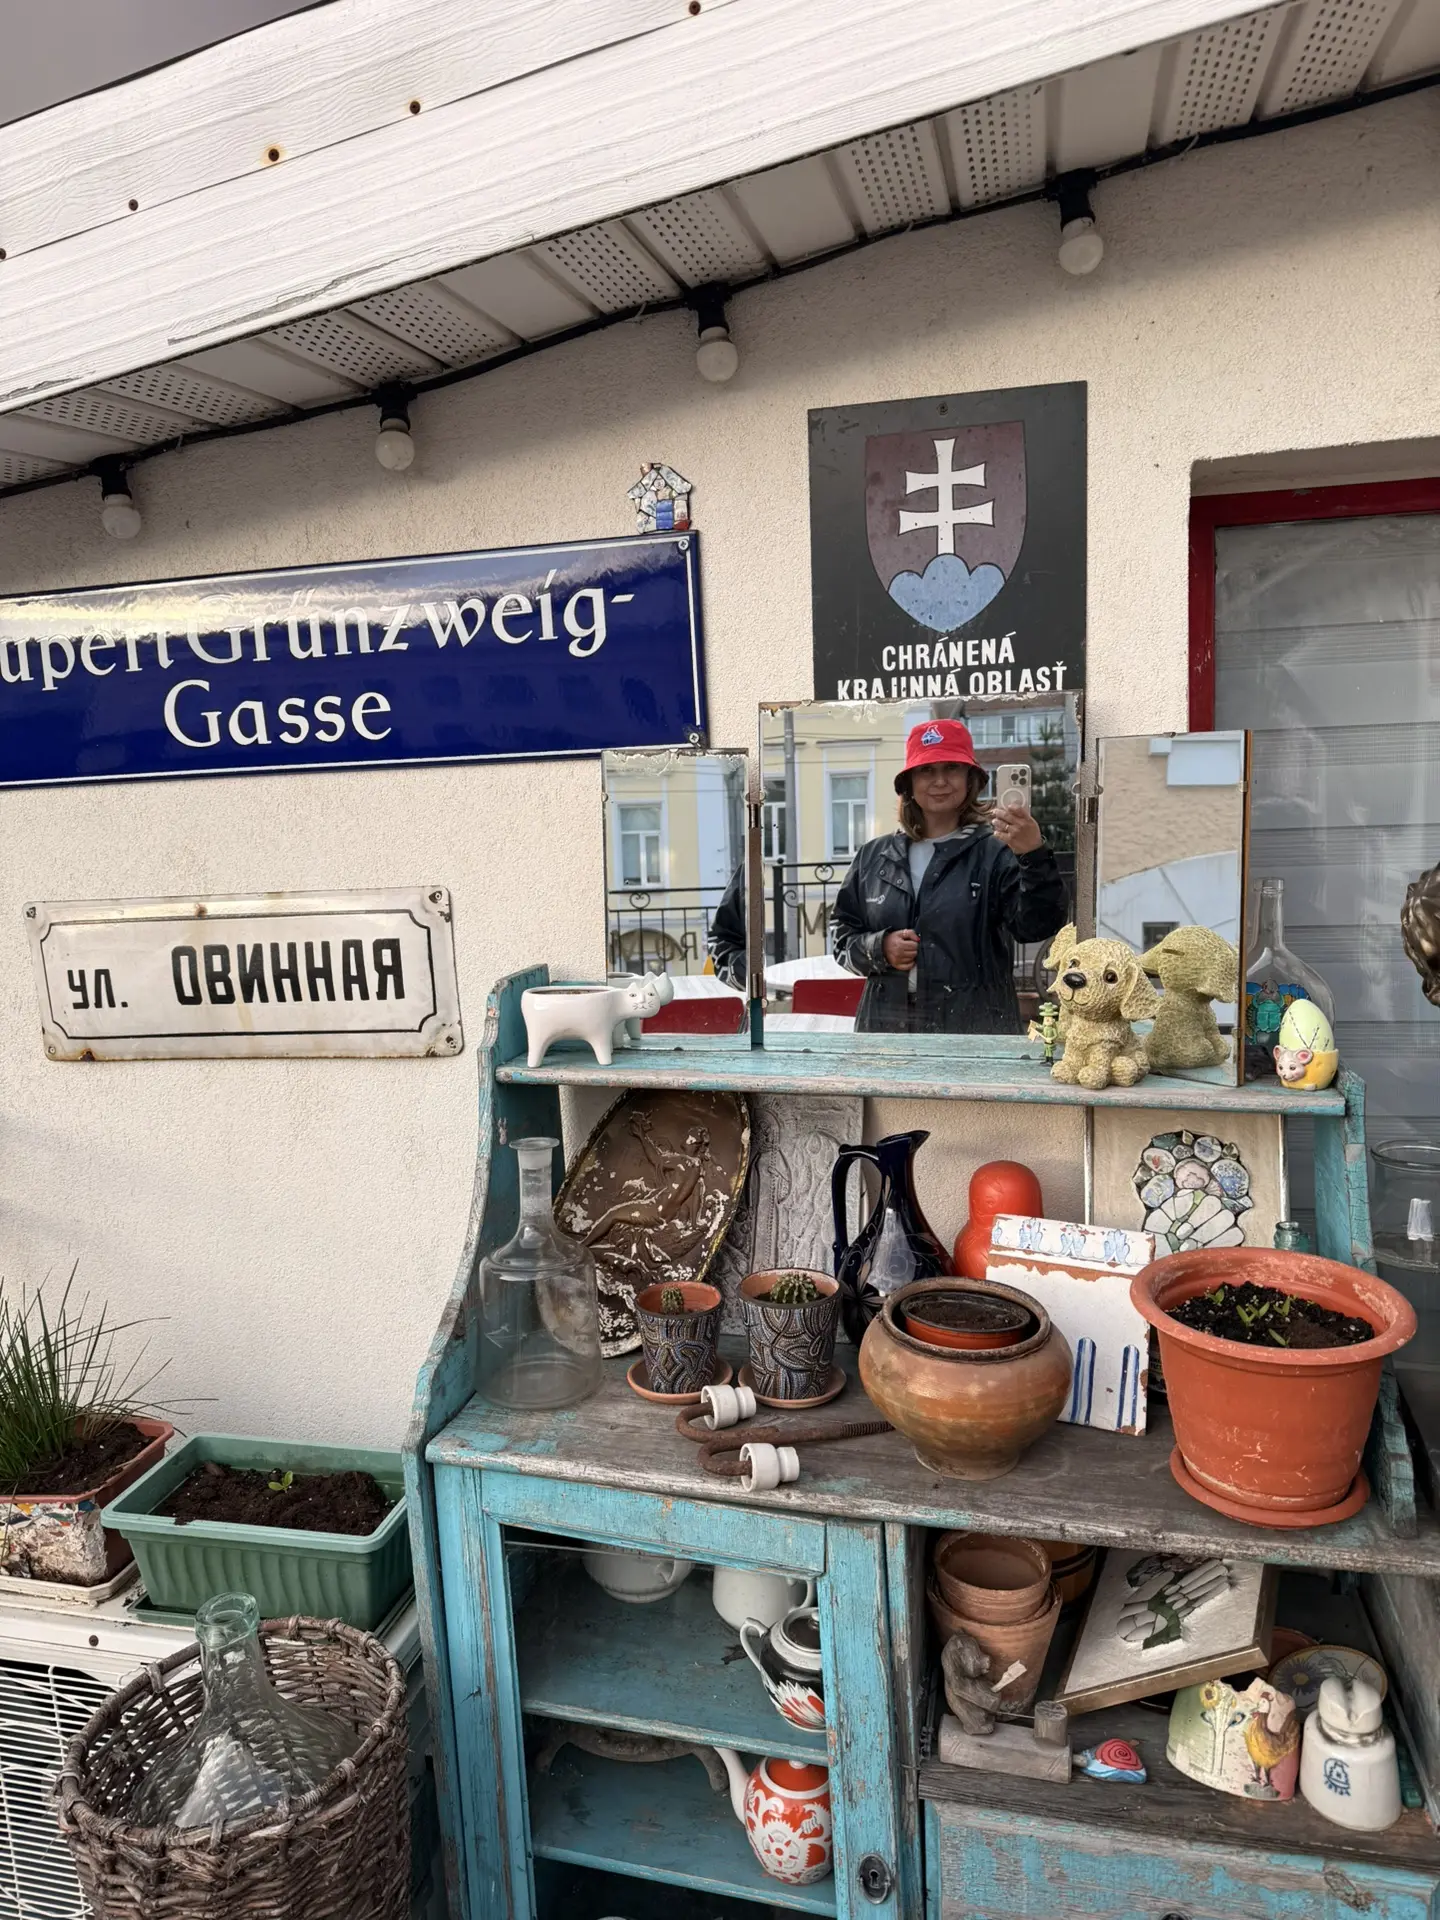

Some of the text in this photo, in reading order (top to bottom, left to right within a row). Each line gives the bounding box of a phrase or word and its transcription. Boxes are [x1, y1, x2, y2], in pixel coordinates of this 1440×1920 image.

[882, 631, 1017, 672] CHRÁNENÁ
[969, 660, 1068, 695] OBLASŤ
[164, 679, 392, 748] Gasse
[171, 937, 405, 1006] ОВИННАЯ
